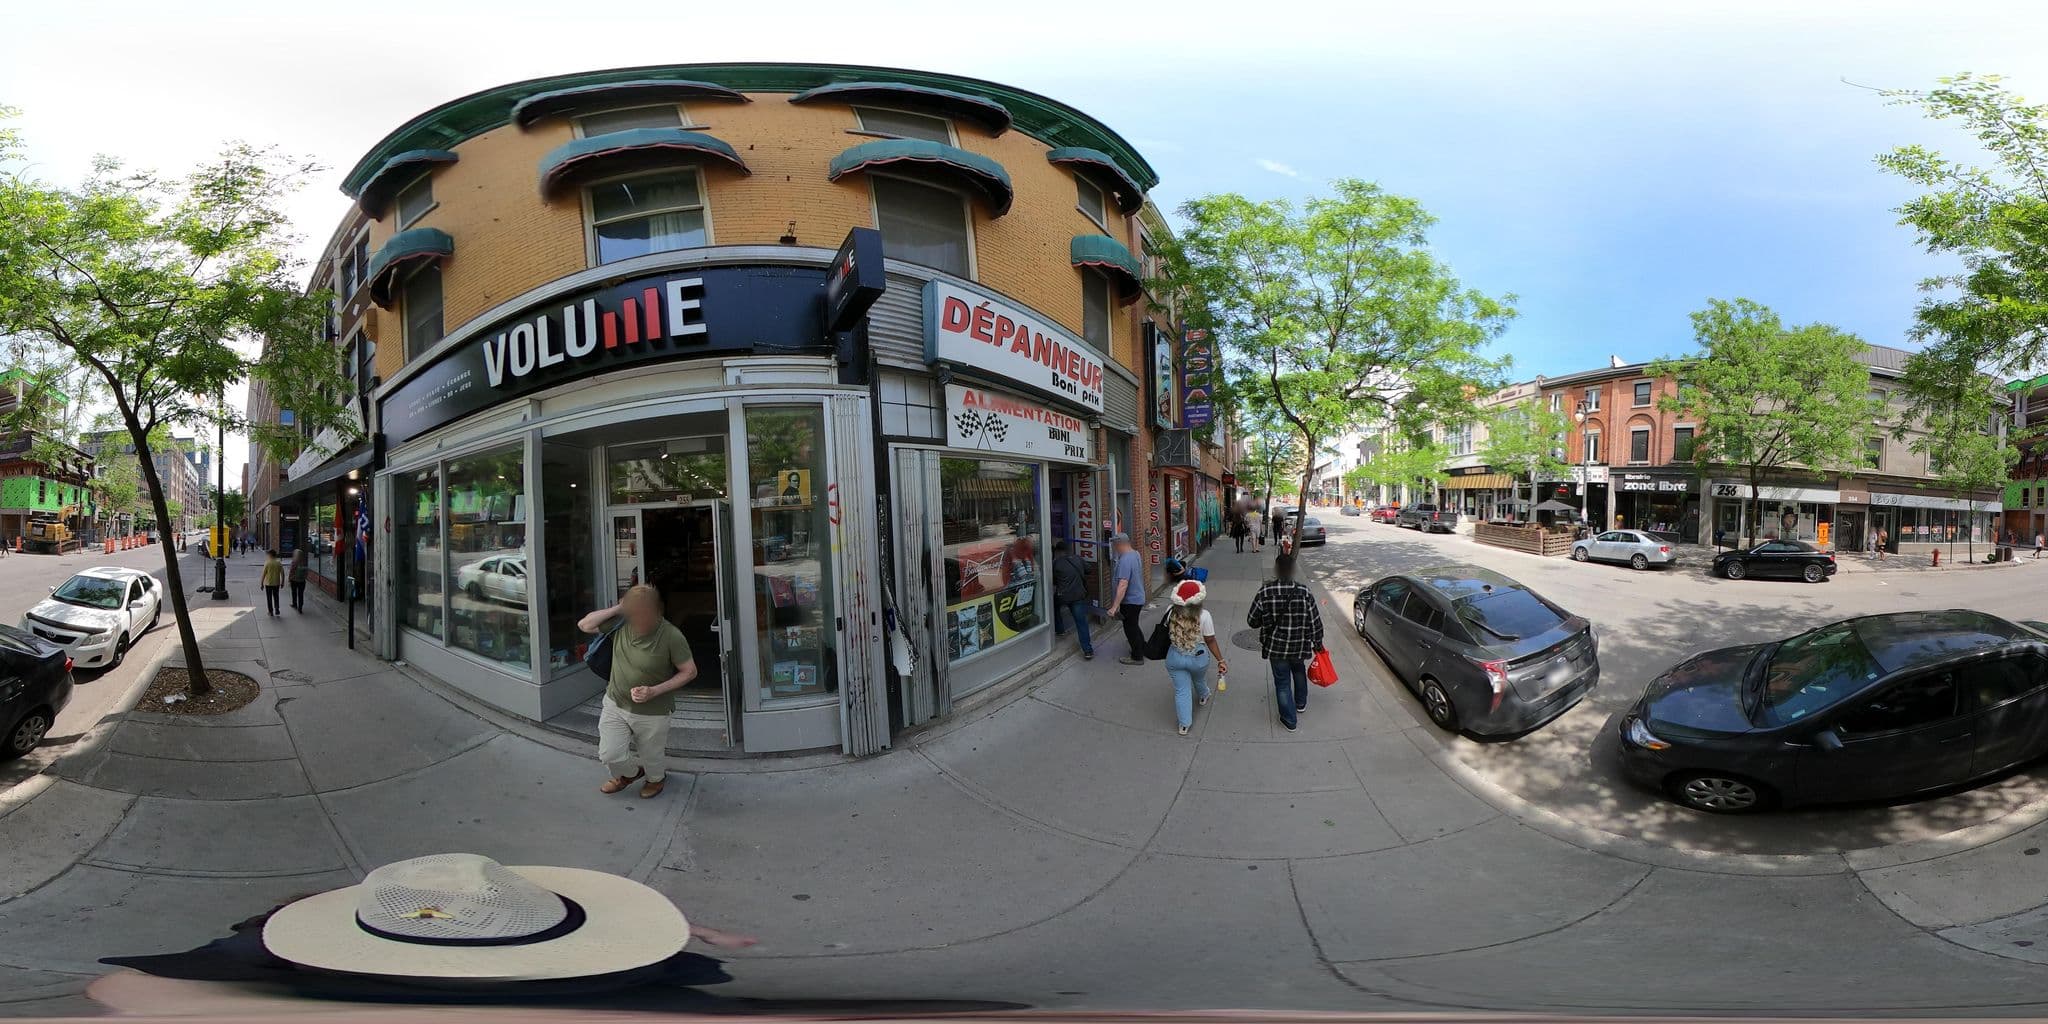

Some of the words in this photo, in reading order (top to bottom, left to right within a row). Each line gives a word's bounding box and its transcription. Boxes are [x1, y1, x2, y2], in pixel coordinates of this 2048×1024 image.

[483, 277, 708, 387] VOLUME
[941, 295, 1102, 393] DÉPANNEUR
[1052, 372, 1077, 395] Boni
[1082, 390, 1099, 405] prix
[962, 389, 1081, 433] ALIMENTATION
[1048, 426, 1070, 443] BONI
[1064, 443, 1084, 458] PRIX
[1624, 482, 1655, 491] zone
[1659, 481, 1687, 491] libre
[1717, 485, 1737, 496] 256
[1149, 470, 1161, 564] MASSAGE
